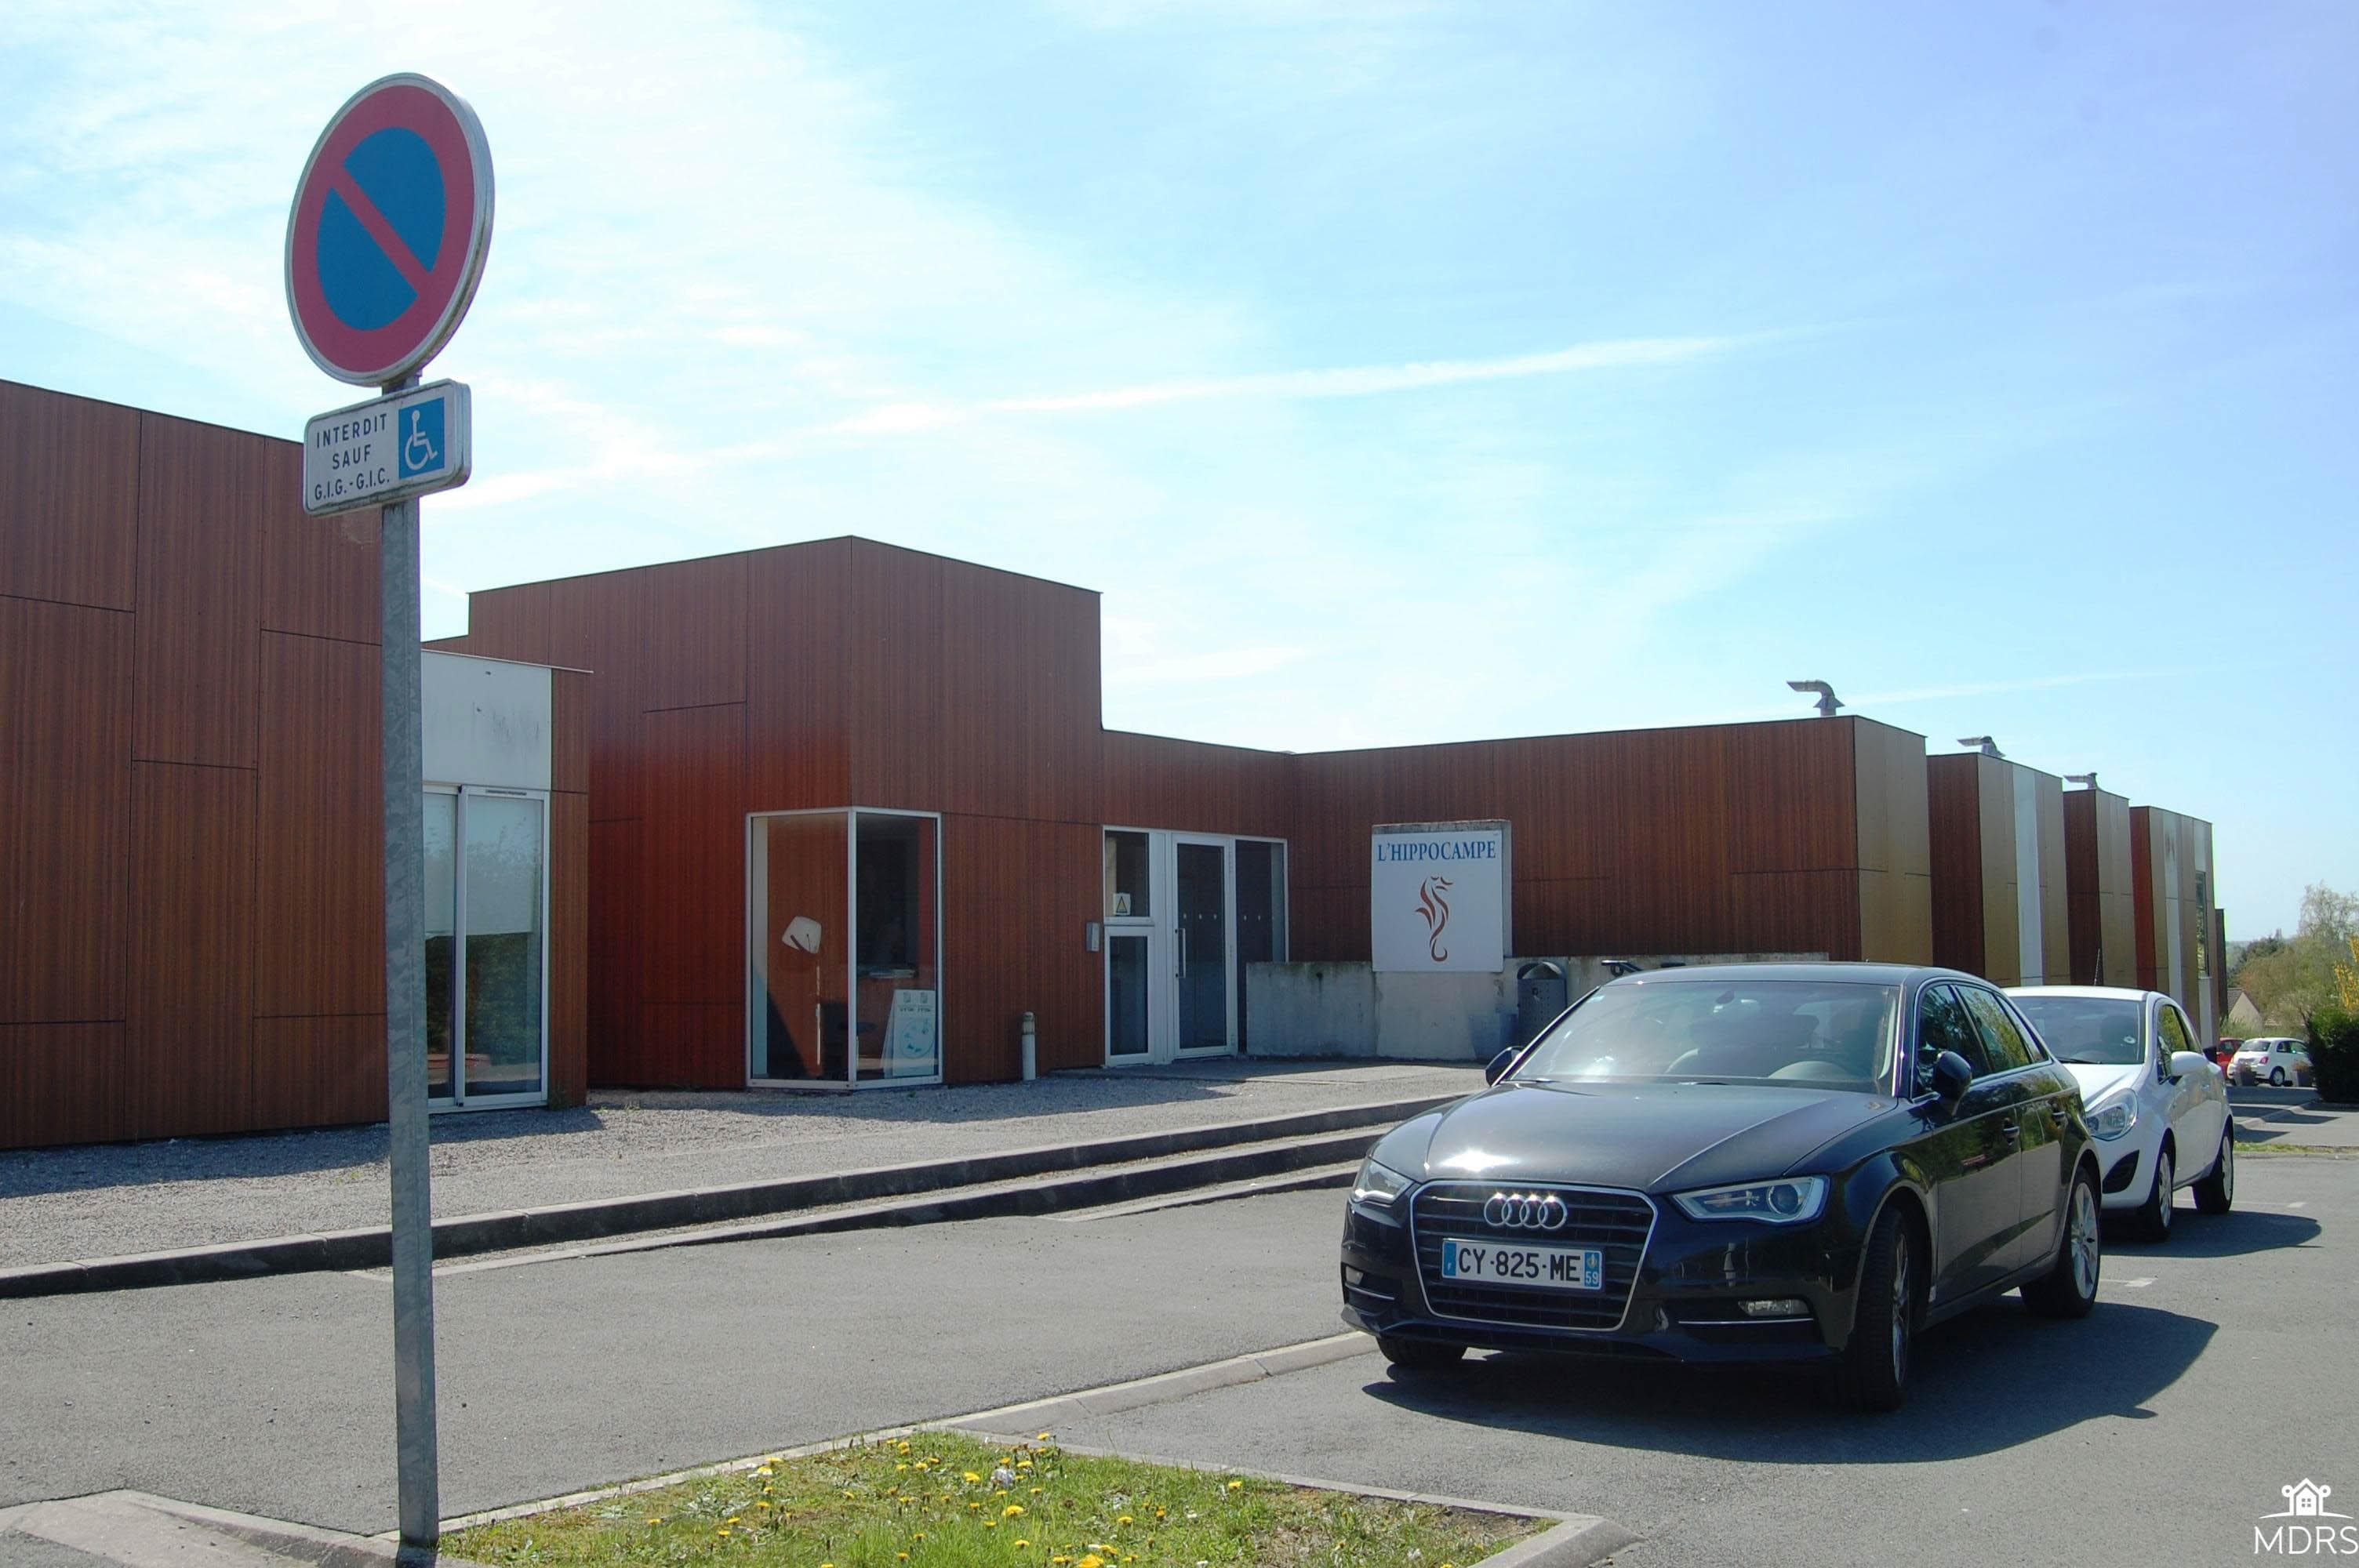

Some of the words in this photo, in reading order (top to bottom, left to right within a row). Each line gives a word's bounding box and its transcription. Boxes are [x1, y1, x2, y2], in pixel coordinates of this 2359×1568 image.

[316, 413, 387, 448] INTERDIT
[332, 444, 372, 470] SAUF
[1378, 840, 1496, 862] L'HIPPOCAMPE
[1585, 1271, 1598, 1284] 59
